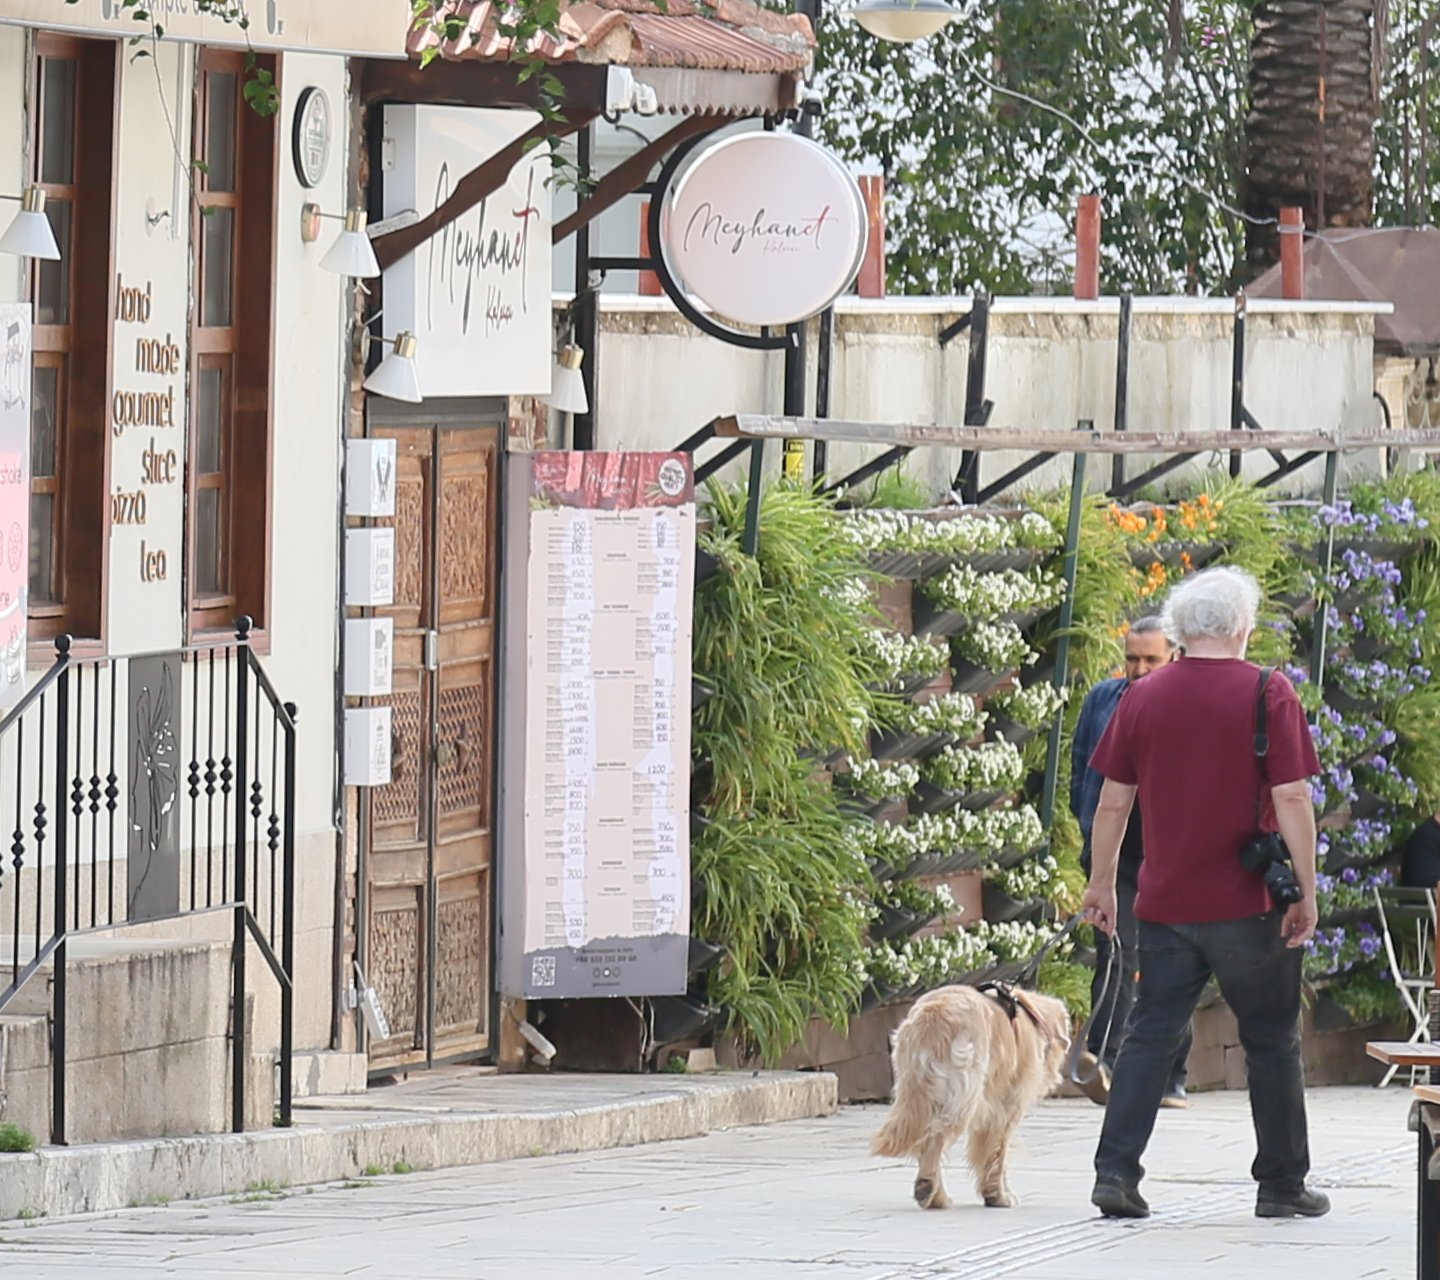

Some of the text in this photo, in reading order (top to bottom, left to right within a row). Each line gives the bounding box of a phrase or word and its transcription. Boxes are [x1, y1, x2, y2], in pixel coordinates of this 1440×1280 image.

[115, 272, 151, 323] hand
[136, 333, 180, 375] made
[113, 385, 175, 437] gourmet
[141, 437, 176, 484] slice
[140, 539, 167, 583] tea
